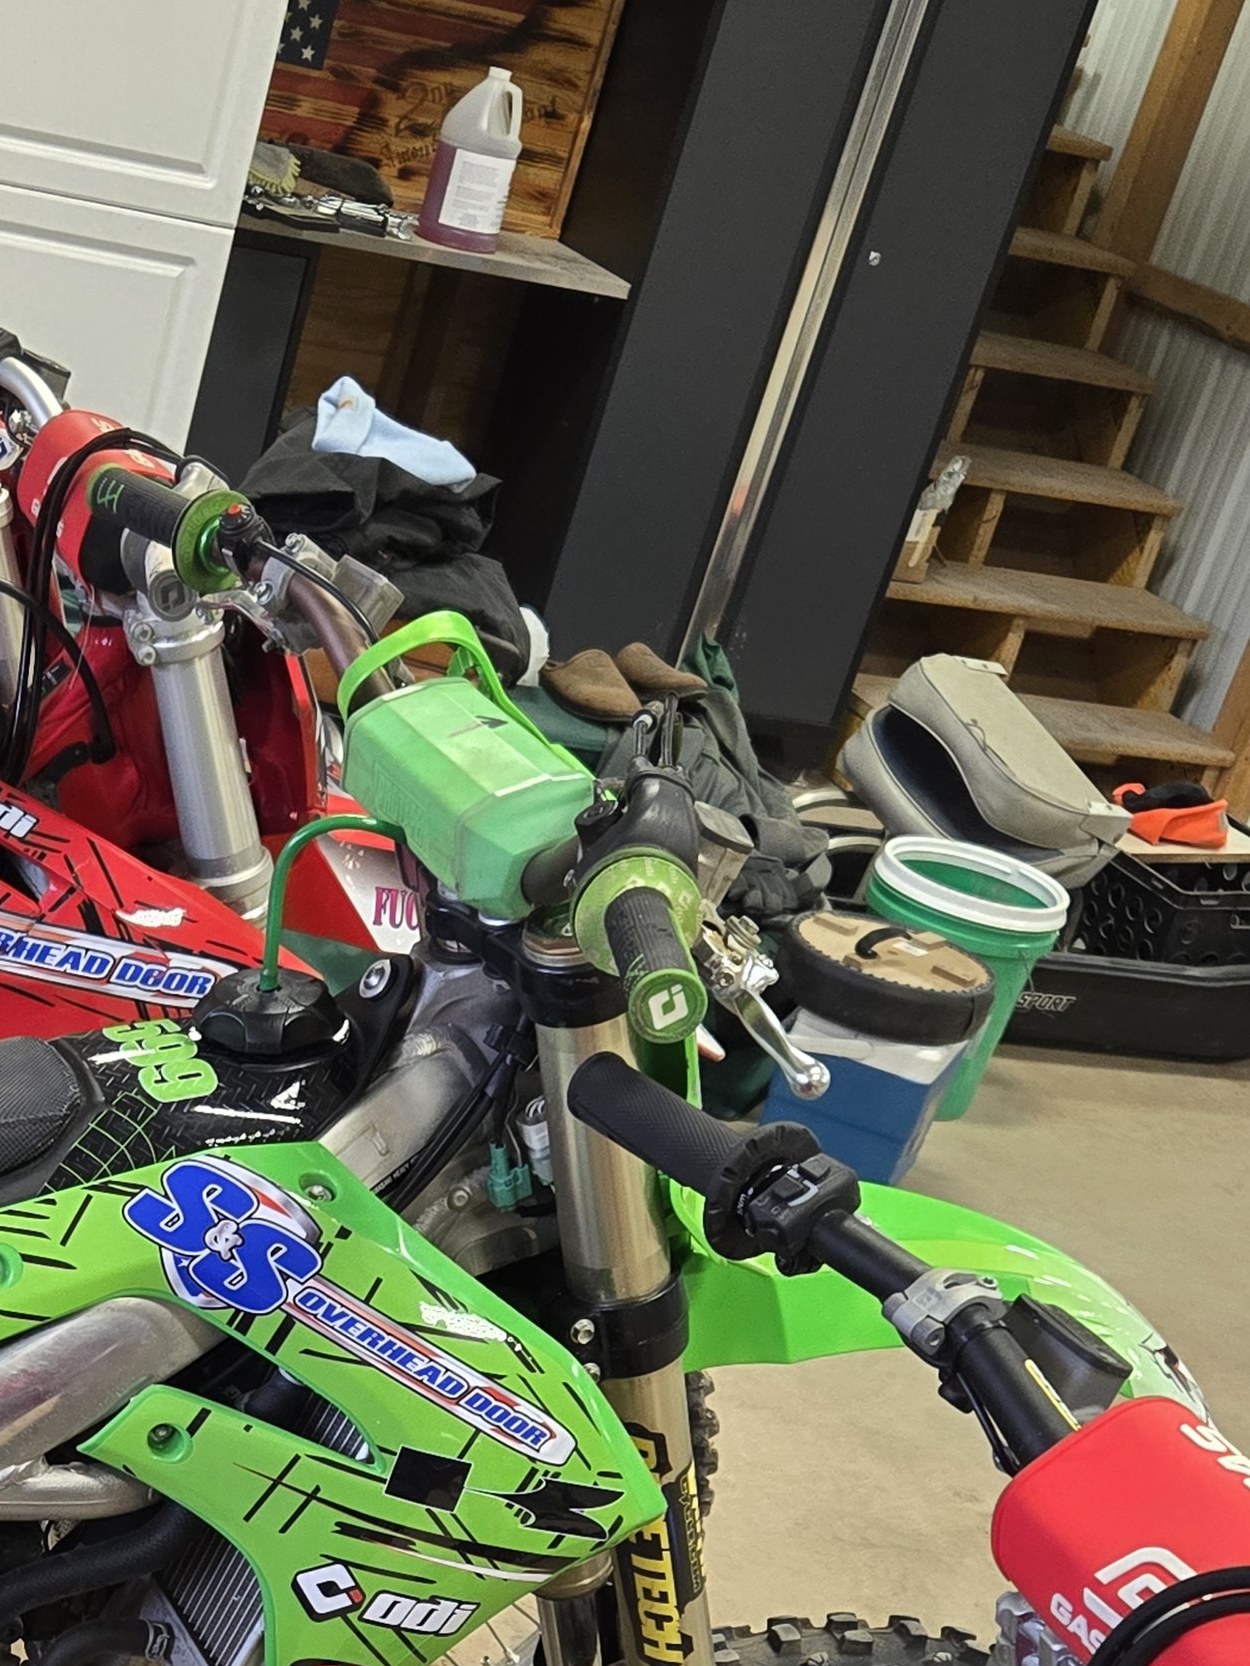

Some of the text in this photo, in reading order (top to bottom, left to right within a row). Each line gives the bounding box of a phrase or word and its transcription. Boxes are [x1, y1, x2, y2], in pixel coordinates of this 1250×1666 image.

[113, 953, 216, 998] DOOR
[102, 1018, 219, 1102] 599
[124, 1158, 324, 1313] S&S
[295, 1287, 552, 1451] OVERHEAD DOOR
[359, 1588, 482, 1637] odi
